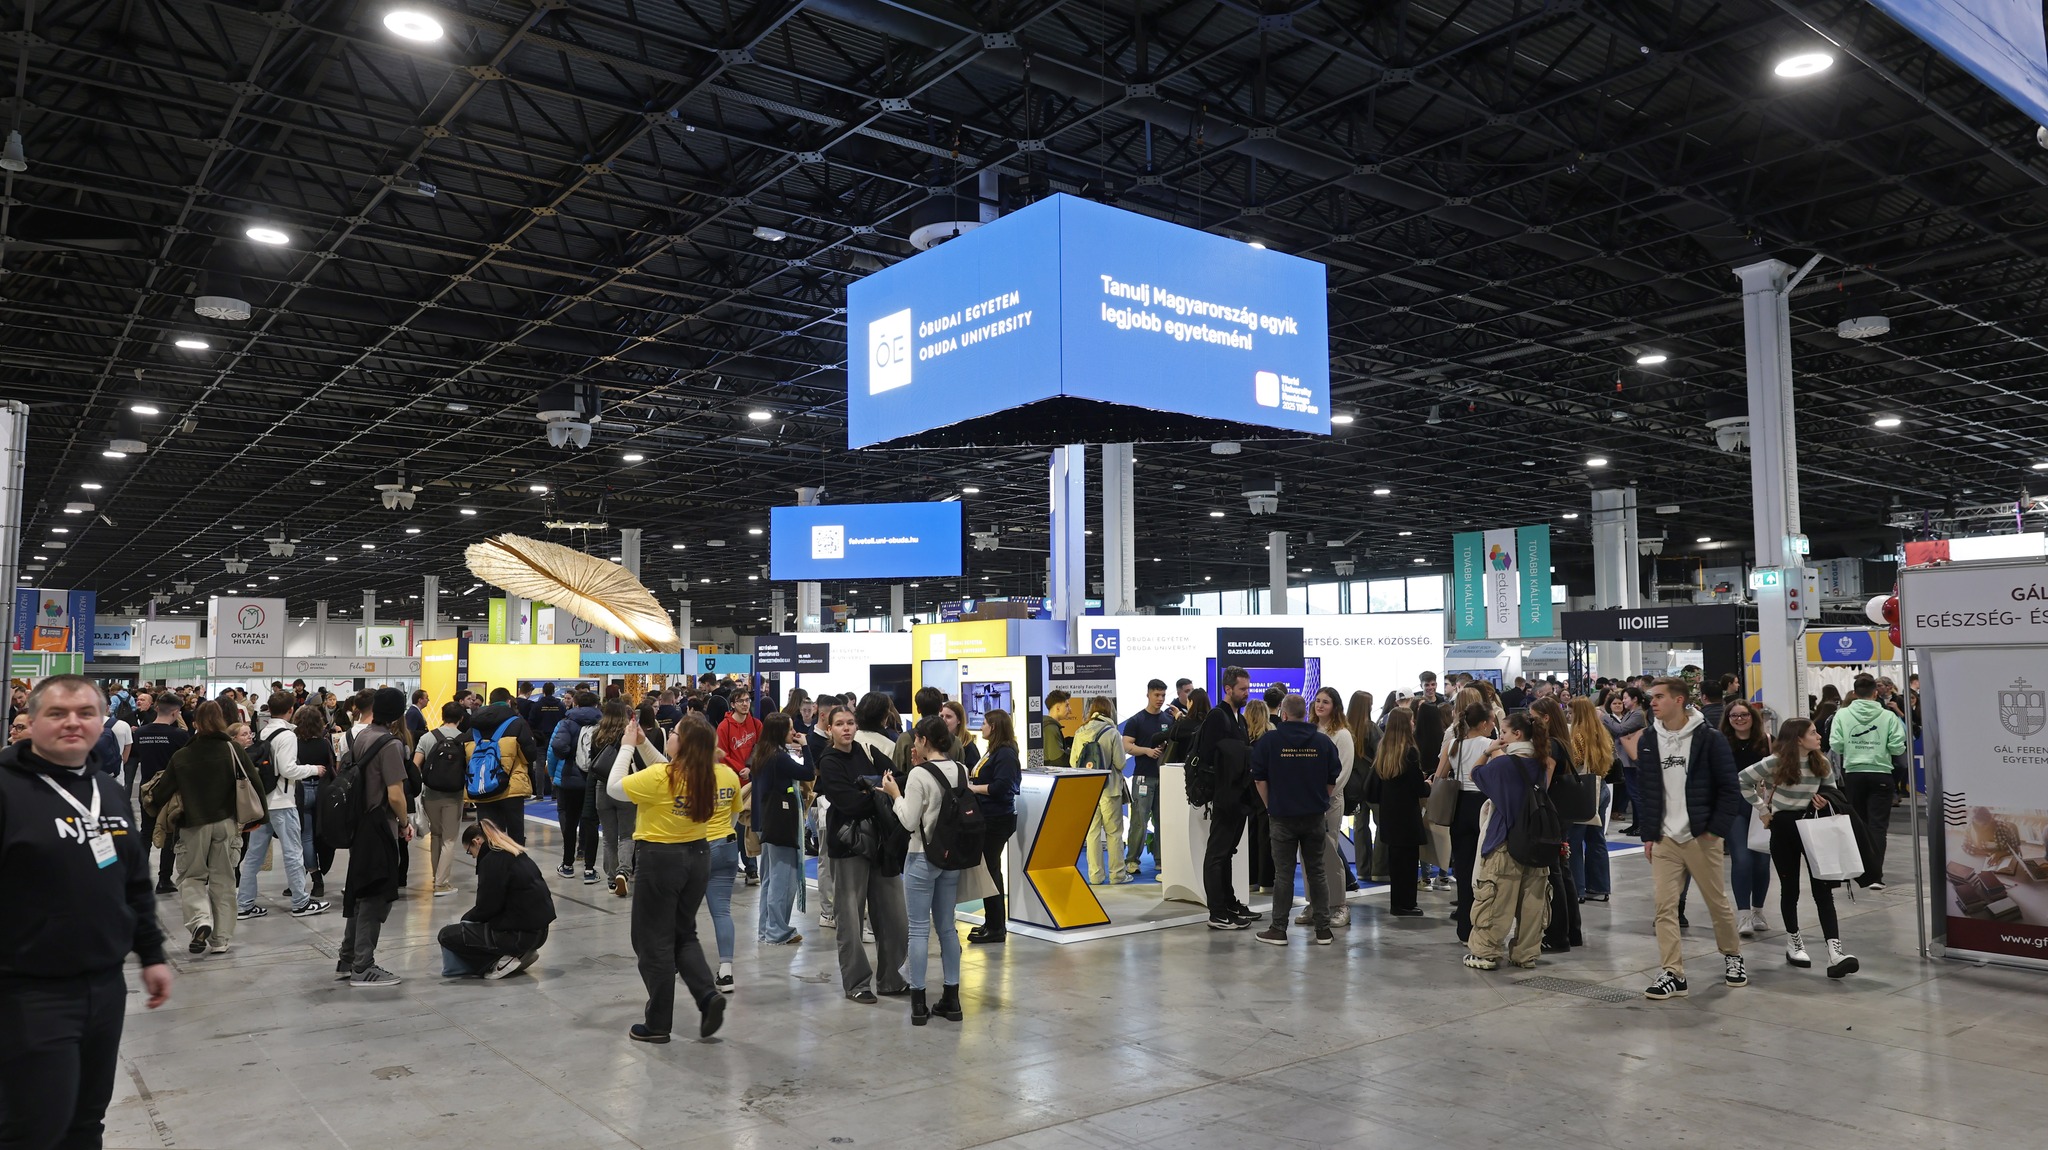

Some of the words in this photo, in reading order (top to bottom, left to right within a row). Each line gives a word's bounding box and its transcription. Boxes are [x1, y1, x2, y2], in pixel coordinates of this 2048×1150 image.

[918, 311, 962, 338] ÓBUDAI
[966, 290, 1020, 322] EGYETEM
[1100, 274, 1150, 307] Tanulj
[1153, 286, 1258, 330] Magyarország
[1260, 314, 1298, 336] egyik
[1102, 302, 1162, 332] legjobb
[1164, 319, 1252, 350] egyetemén!
[919, 337, 958, 362] OBUDA
[961, 310, 1032, 347] UNIVERSITY
[1464, 546, 1472, 582] TOVÁBBI
[1528, 540, 1538, 577] TOVÁBBI
[1464, 584, 1474, 627] KIÁLLÍTÓK
[1498, 572, 1510, 624] educatio
[1530, 580, 1541, 624] KIÁLLÍTÓK
[1916, 609, 2022, 628] EGÉSZSÉG-
[1378, 636, 1432, 645] KÖZÖSSÉG.
[2000, 934, 2048, 948] www.gf
